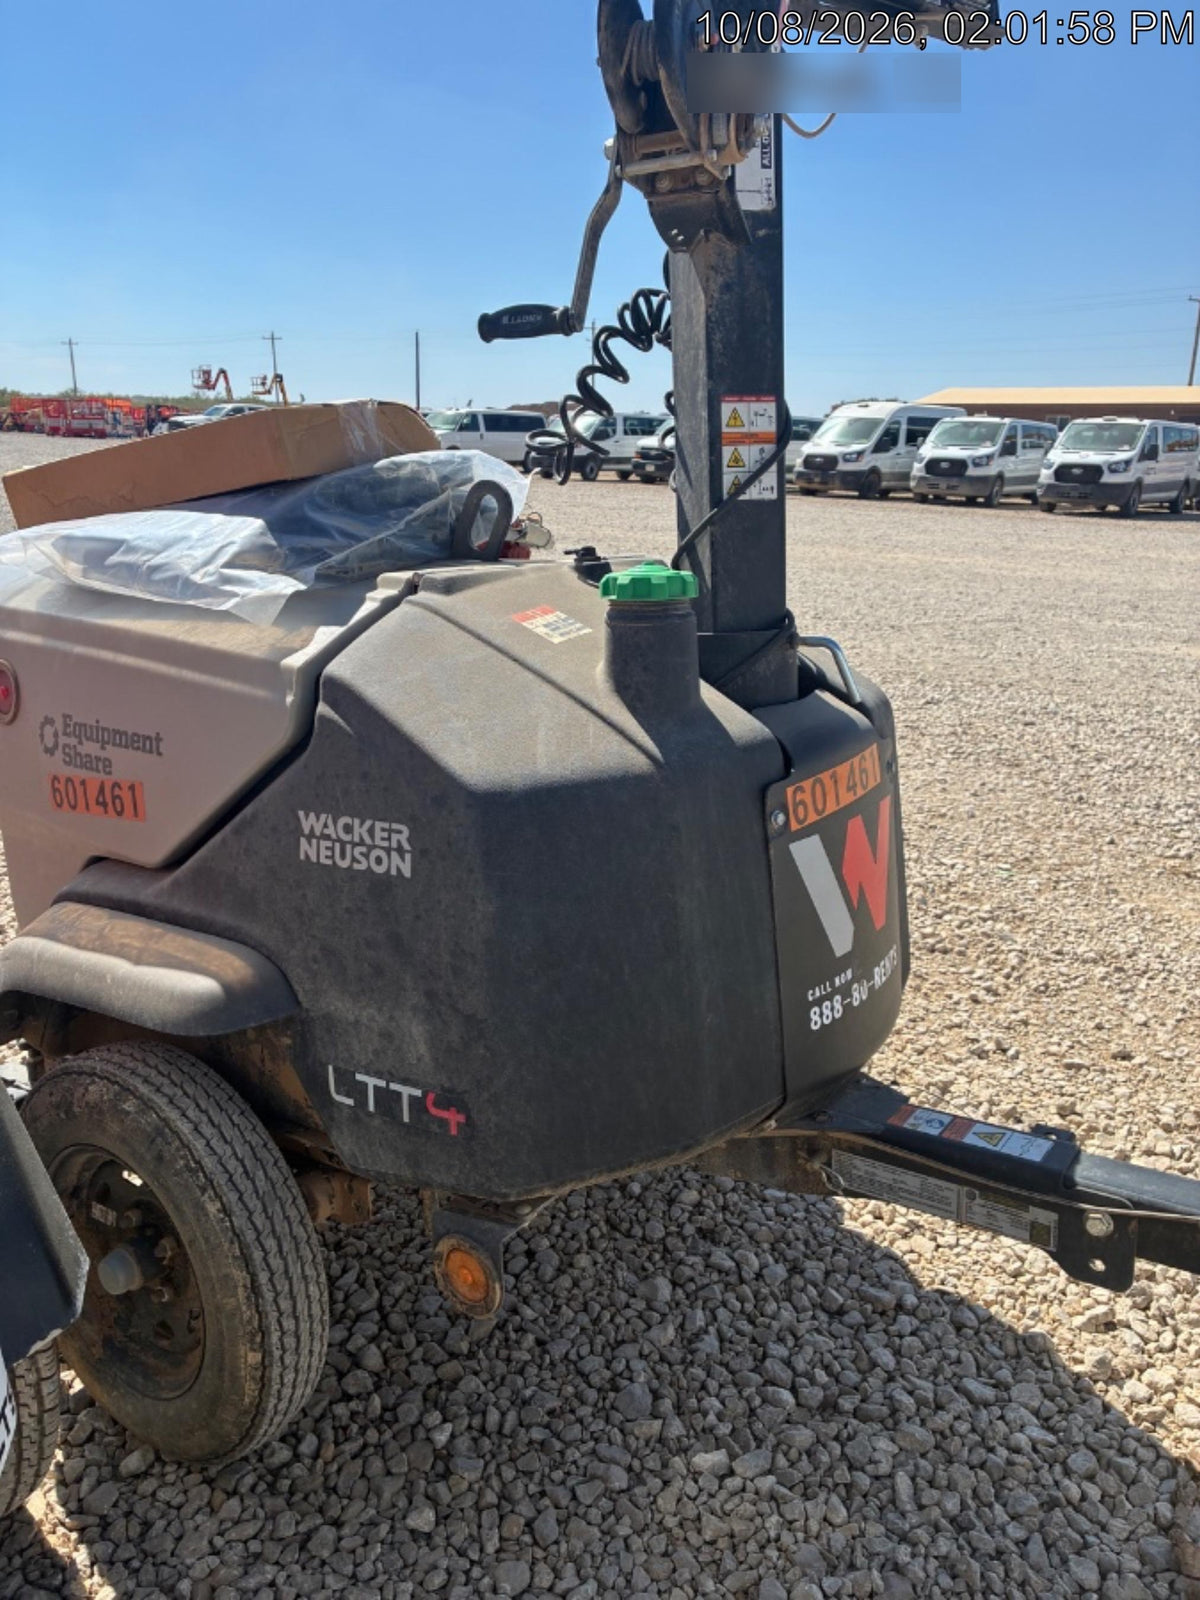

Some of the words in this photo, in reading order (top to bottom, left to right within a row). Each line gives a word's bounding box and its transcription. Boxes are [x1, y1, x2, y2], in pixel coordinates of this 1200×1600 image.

[62, 712, 163, 757] Equipment
[62, 742, 113, 775] Share
[51, 774, 140, 818] 601461
[792, 747, 878, 826] 601461
[298, 810, 412, 851] WACKER
[299, 836, 412, 879] NEUSON
[807, 981, 832, 1001] CALL
[328, 1064, 467, 1137] LTT4
